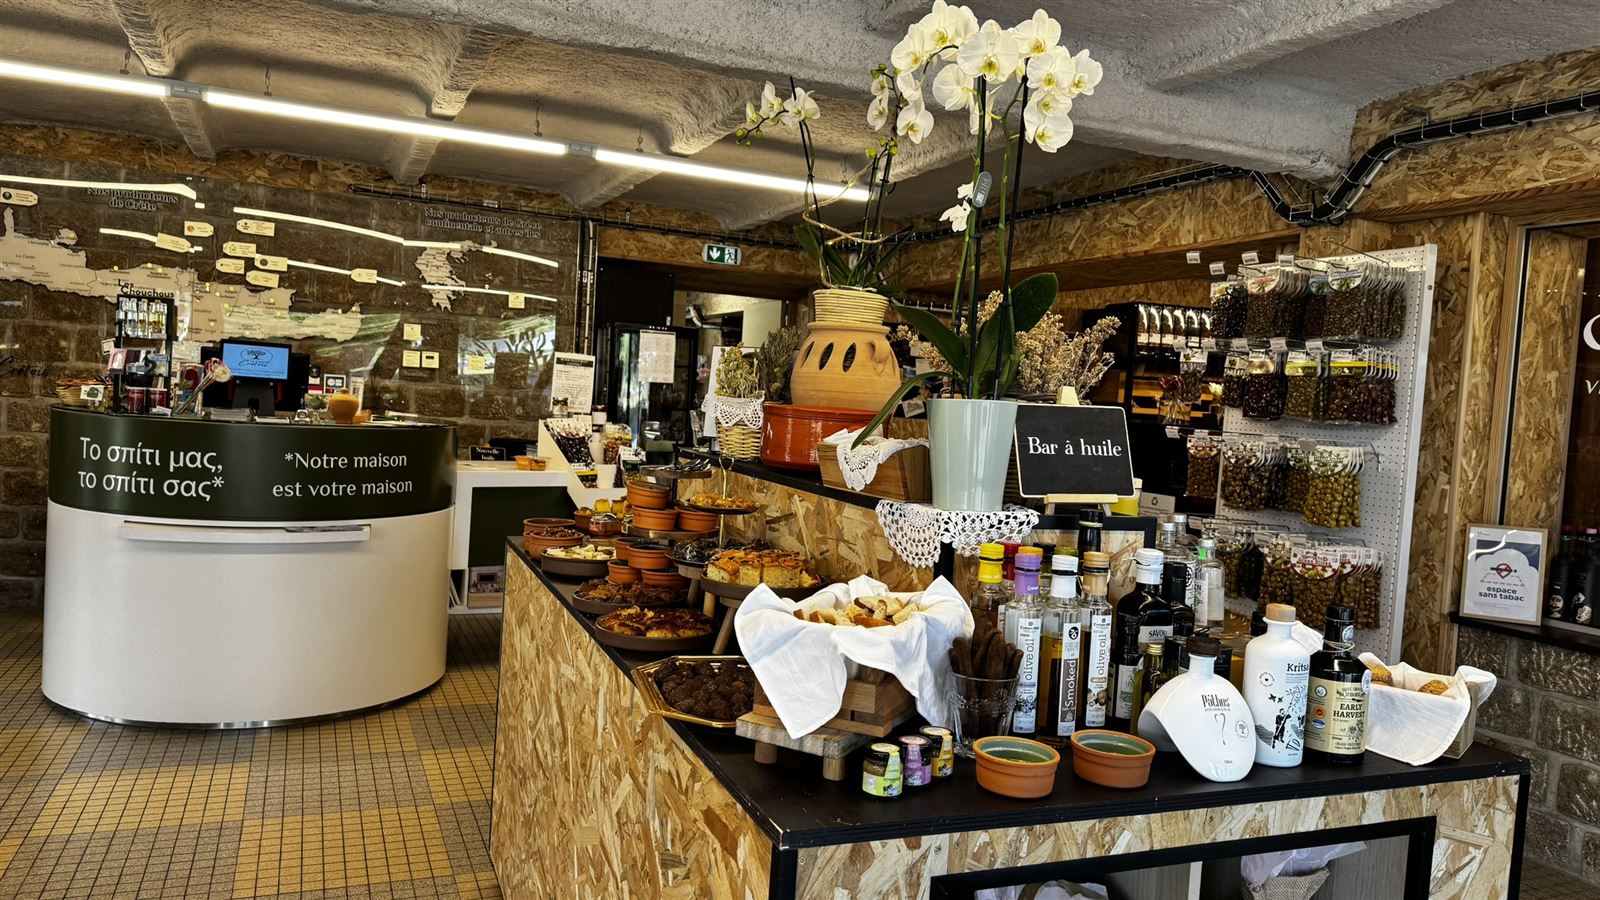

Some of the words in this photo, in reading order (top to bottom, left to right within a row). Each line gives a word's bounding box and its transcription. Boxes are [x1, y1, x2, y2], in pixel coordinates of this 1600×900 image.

[88, 187, 110, 197] Nos
[111, 189, 178, 203] producteurs
[109, 198, 123, 208] de
[125, 199, 156, 211] Crète
[424, 207, 445, 218] Nos
[445, 211, 501, 225] producteurs
[502, 216, 513, 226] de
[514, 218, 542, 230] Grèce
[425, 218, 482, 233] continentale
[484, 225, 493, 233] et
[495, 226, 524, 237] autres
[118, 279, 134, 288] Les
[120, 285, 175, 298] Chouchous
[1027, 436, 1058, 455] Bar
[1065, 440, 1075, 456] à
[1080, 438, 1122, 457] huile
[107, 442, 160, 466] σπίτι
[169, 450, 223, 473] μας,
[353, 453, 407, 468] maison
[78, 471, 97, 489] το
[102, 471, 155, 495] σπίτι
[272, 482, 302, 497] est
[308, 481, 357, 496] votre
[362, 480, 412, 495] maison
[1478, 591, 1498, 599] sans
[1499, 593, 1524, 602] tabac
[1486, 586, 1517, 595] espace
[1023, 653, 1034, 680] olive
[1096, 648, 1106, 675] olive
[1065, 660, 1076, 707] Smoked
[1333, 710, 1365, 718] HARVEST
[1340, 703, 1363, 711] EARLY
